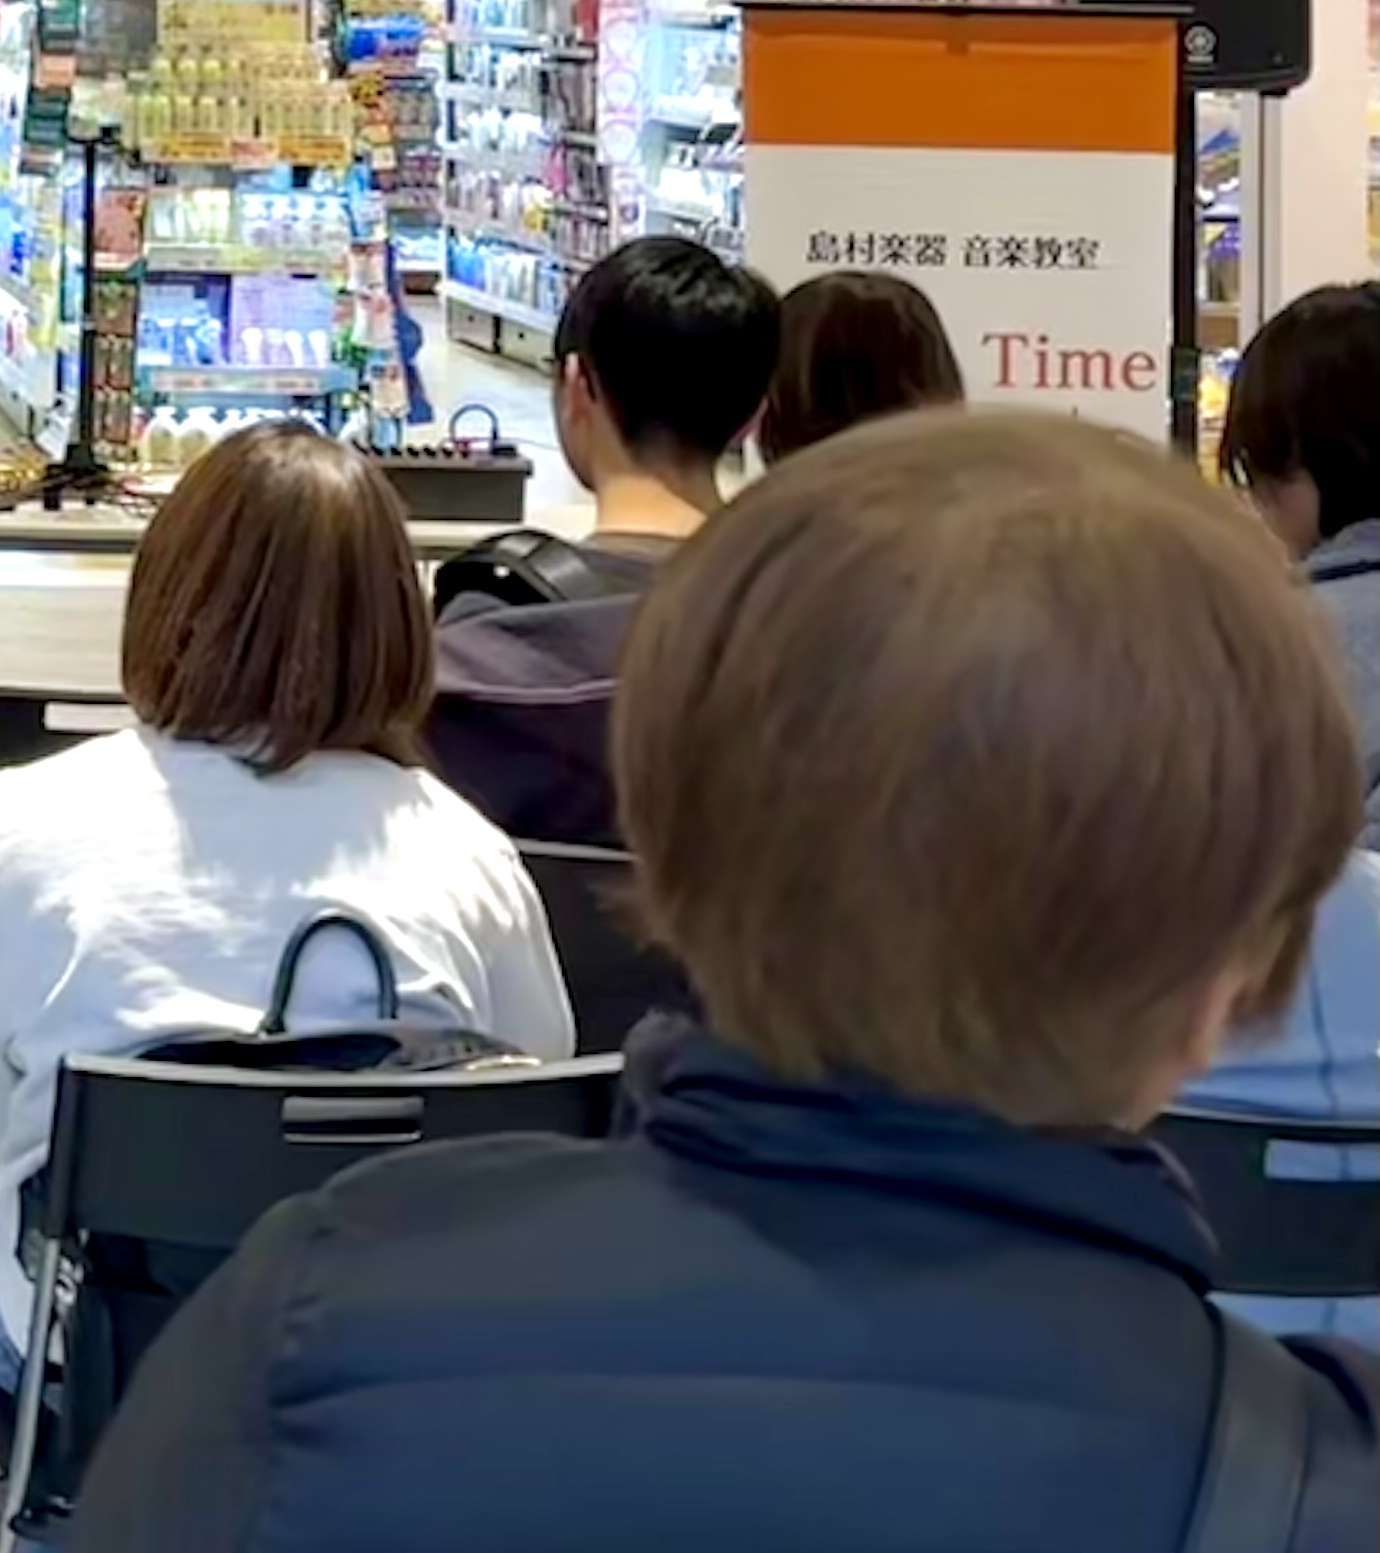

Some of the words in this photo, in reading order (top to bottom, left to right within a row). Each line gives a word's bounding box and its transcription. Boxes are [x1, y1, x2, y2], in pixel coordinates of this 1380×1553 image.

[806, 230, 947, 265] 島村楽器
[961, 233, 1100, 270] 音楽教室
[981, 333, 1158, 390] Time
